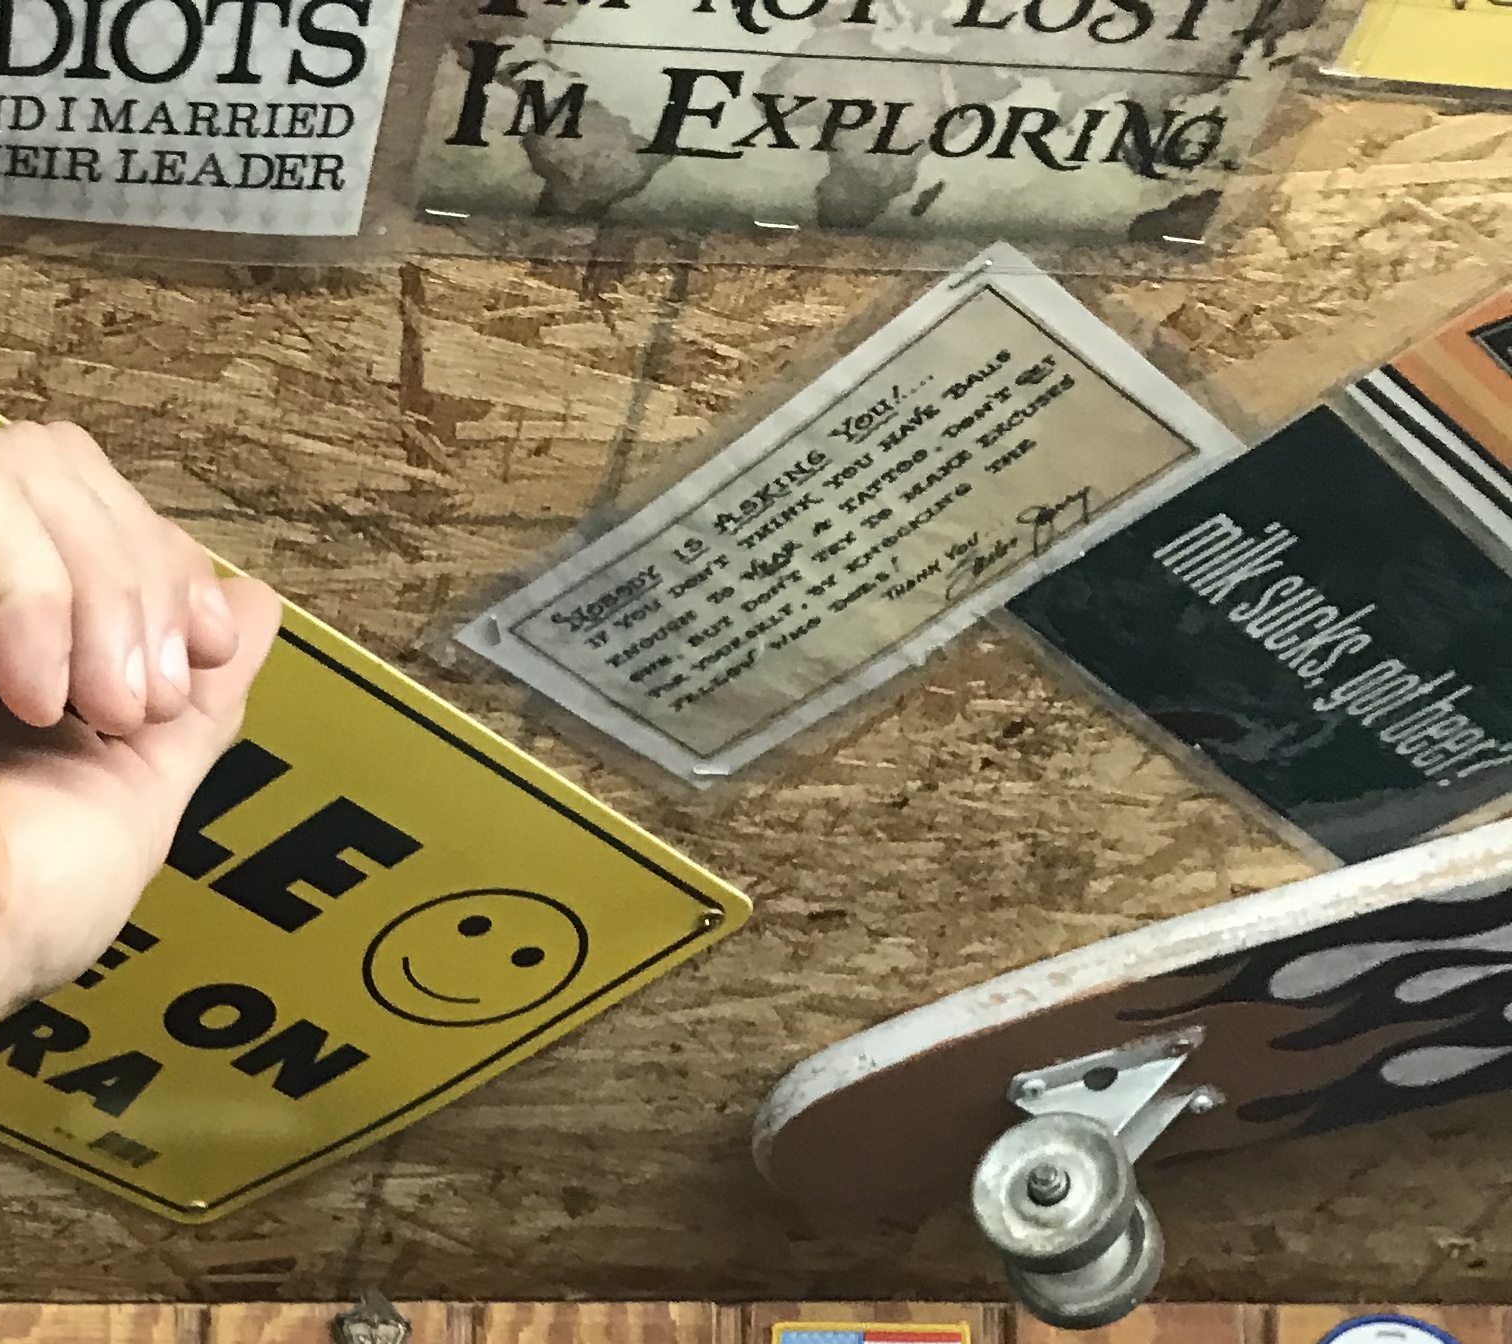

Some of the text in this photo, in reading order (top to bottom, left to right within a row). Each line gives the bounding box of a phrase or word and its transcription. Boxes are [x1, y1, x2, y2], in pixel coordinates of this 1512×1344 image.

[56, 97, 76, 132] I
[88, 98, 356, 138] MARRIED
[115, 148, 346, 191] LEADER
[669, 537, 704, 563] IS
[712, 449, 831, 535] ASKING
[821, 451, 874, 490] YOU
[1152, 513, 1299, 605] milk
[1312, 658, 1457, 728] got
[163, 983, 370, 1098] ON
